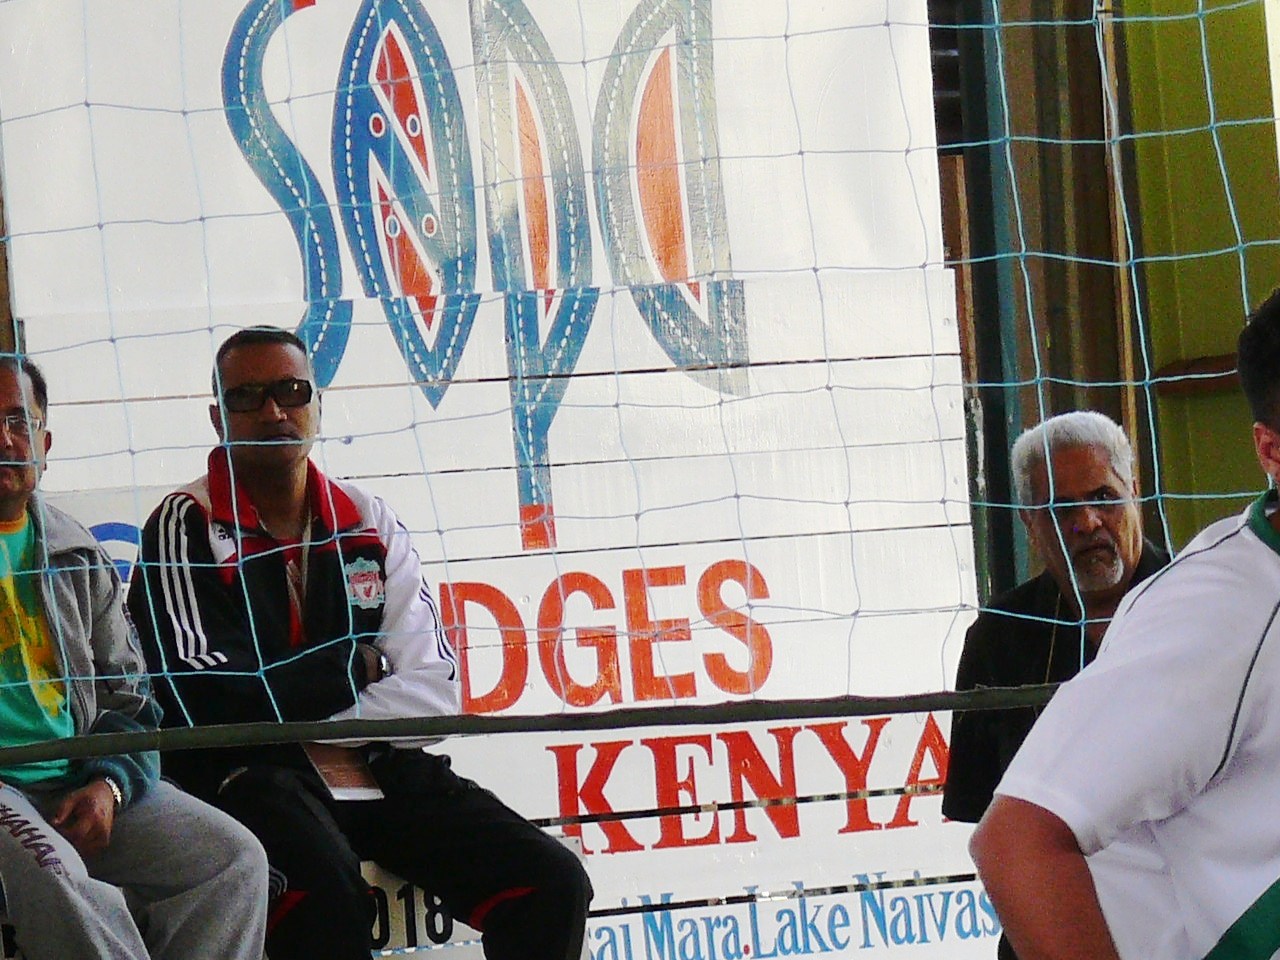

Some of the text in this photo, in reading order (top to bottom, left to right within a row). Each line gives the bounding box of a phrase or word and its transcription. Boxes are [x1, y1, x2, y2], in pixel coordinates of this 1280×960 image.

[439, 559, 773, 714] DGES
[545, 711, 951, 856] KENYA
[852, 870, 1002, 949] Naivas
